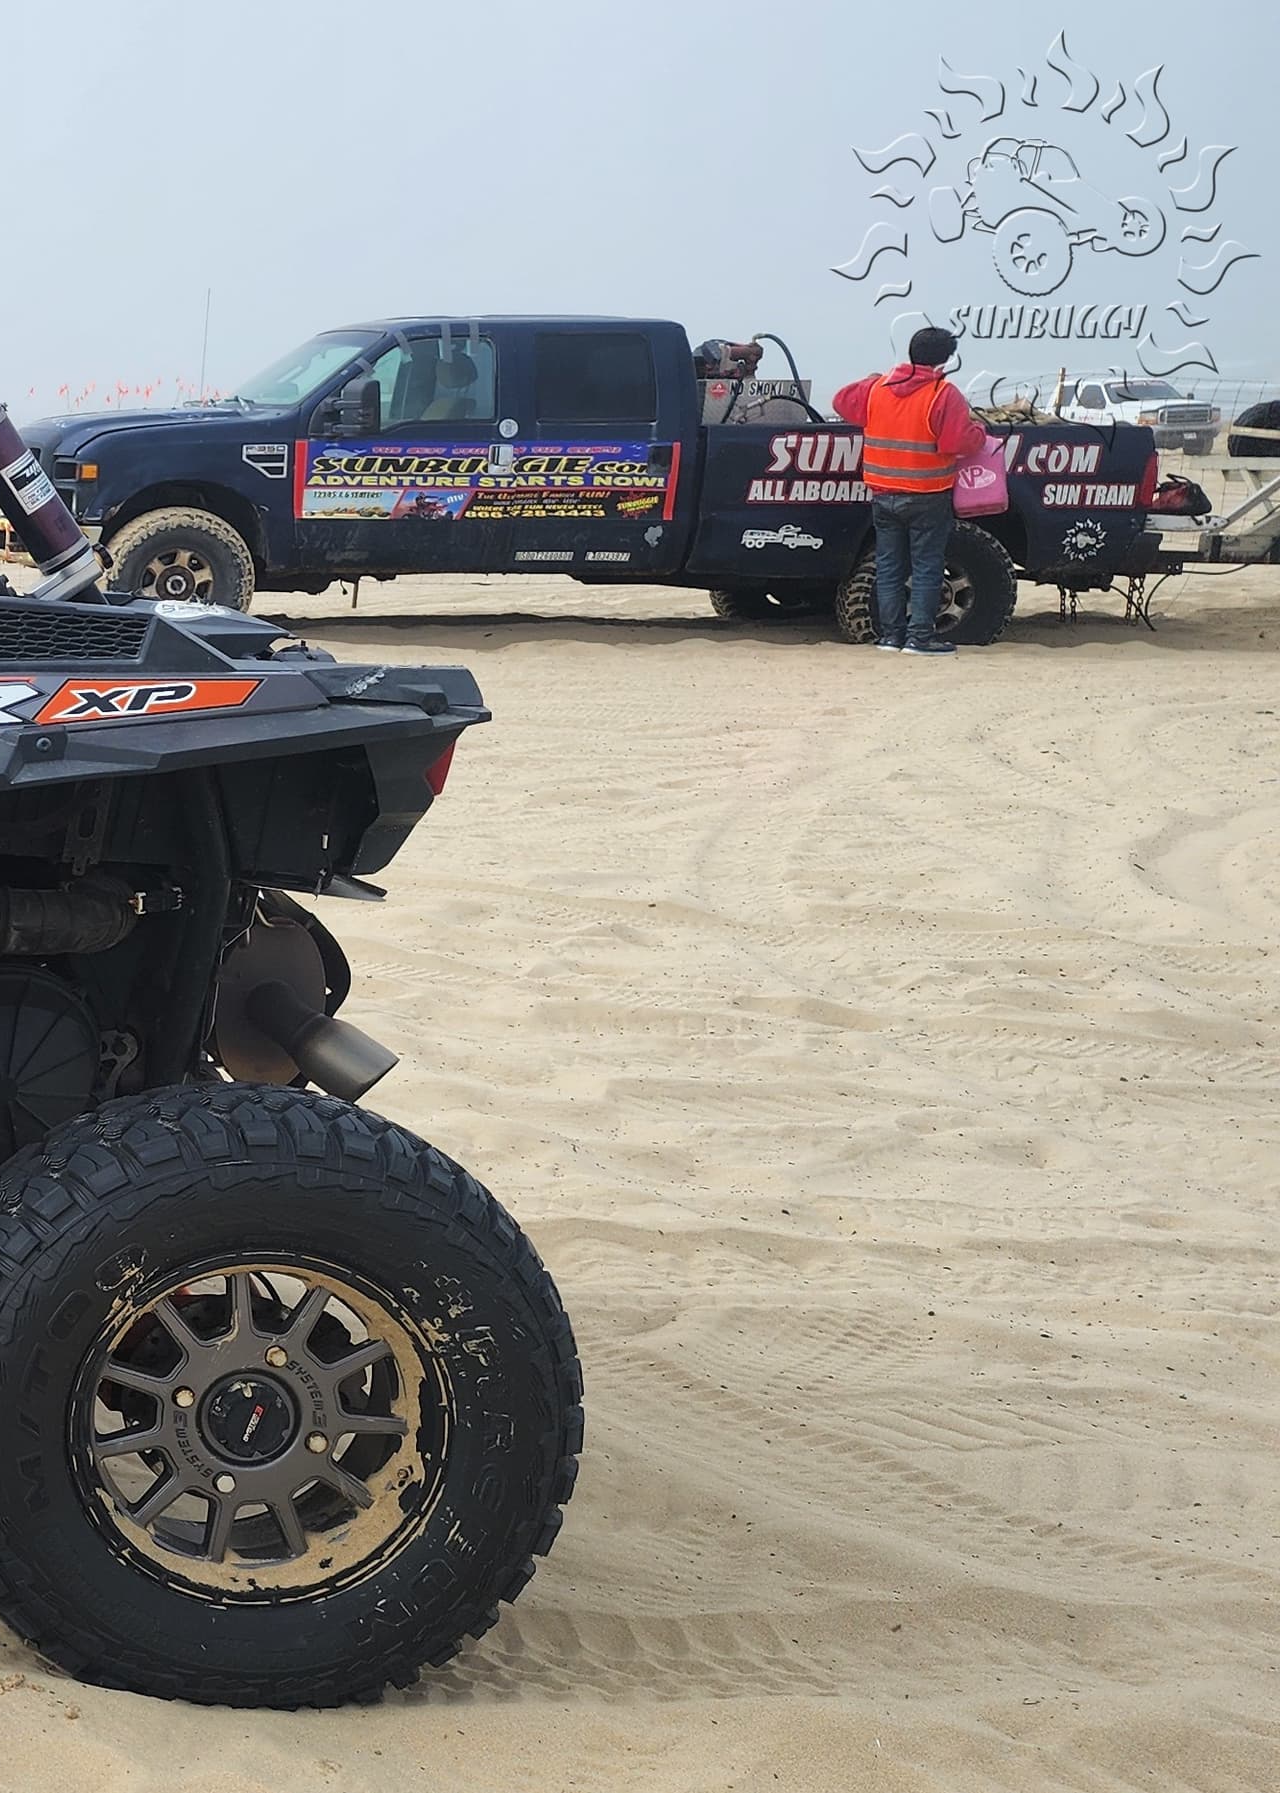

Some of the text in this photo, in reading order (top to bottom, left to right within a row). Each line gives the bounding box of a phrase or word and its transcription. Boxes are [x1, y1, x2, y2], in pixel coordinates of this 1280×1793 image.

[750, 381, 798, 396] SMOKIG
[307, 475, 665, 488] ADVENTURE STARTS NOW!
[748, 481, 786, 502] ALL
[1043, 484, 1137, 507] SUN TRAM
[52, 684, 195, 718] XP
